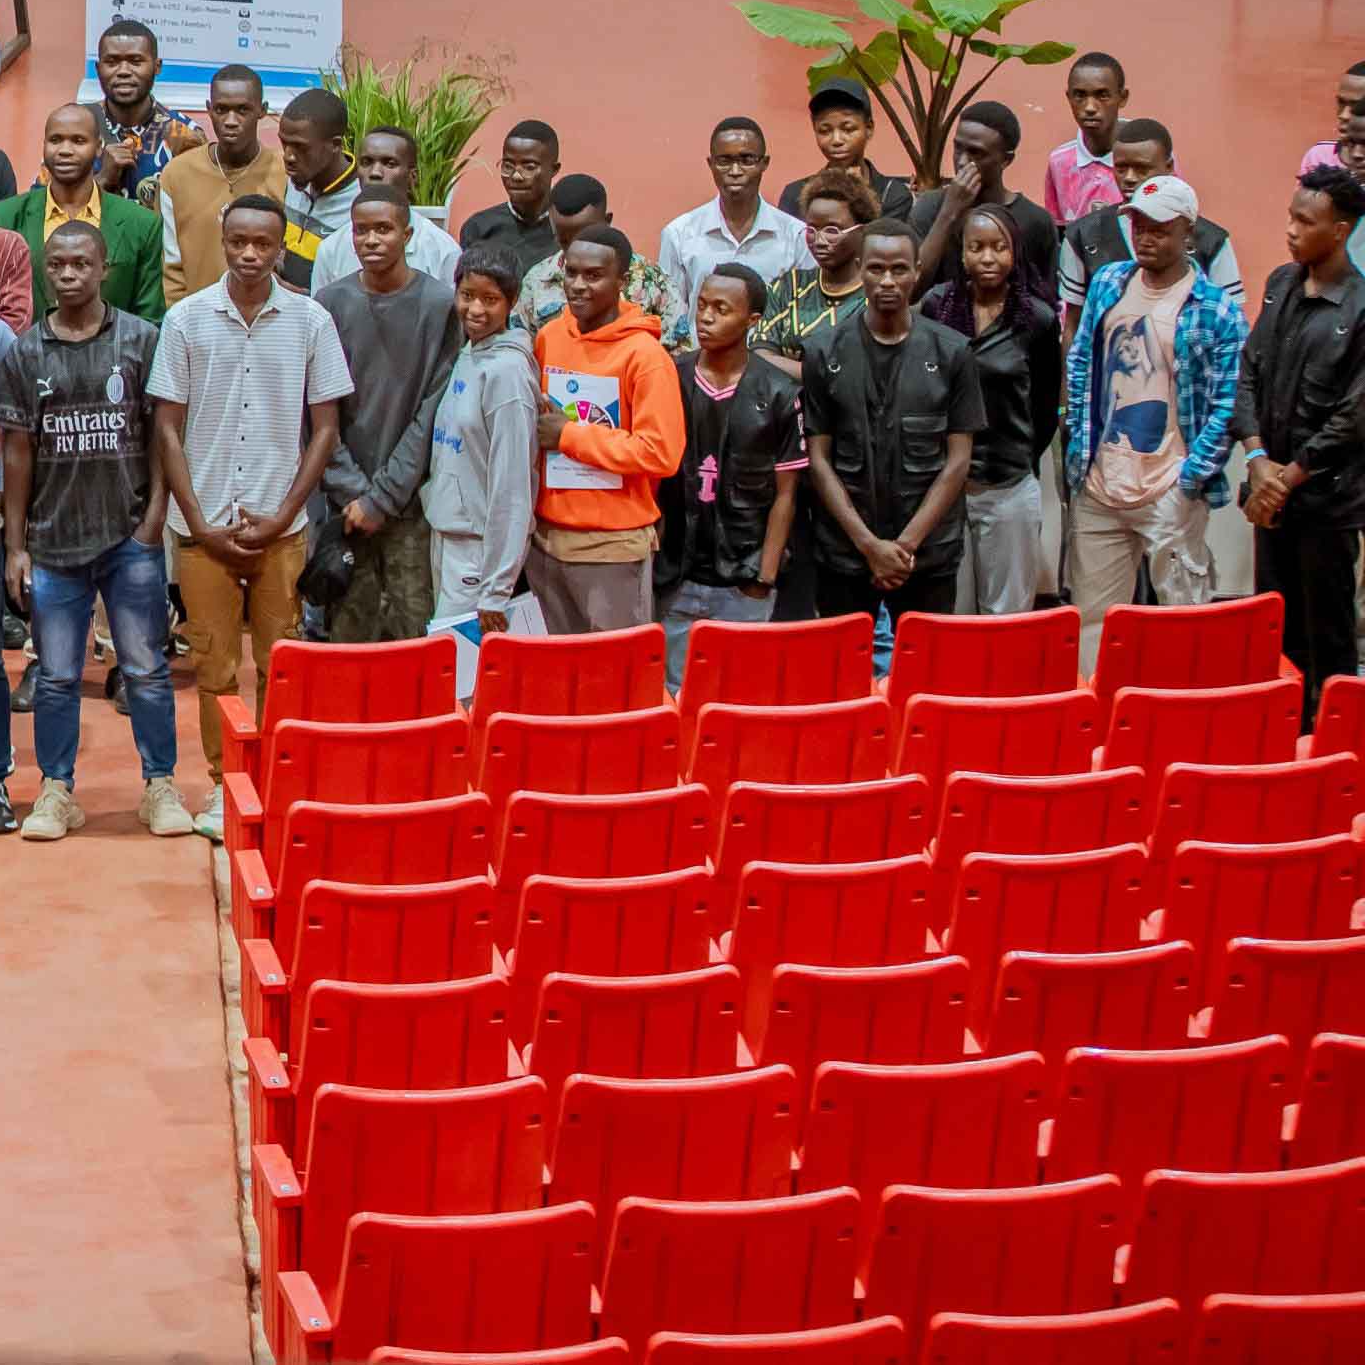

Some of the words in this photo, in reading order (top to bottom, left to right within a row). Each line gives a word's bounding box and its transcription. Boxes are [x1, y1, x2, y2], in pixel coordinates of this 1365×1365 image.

[43, 410, 126, 433] Emirates
[56, 434, 75, 453] FLY
[78, 432, 118, 452] BETTER
